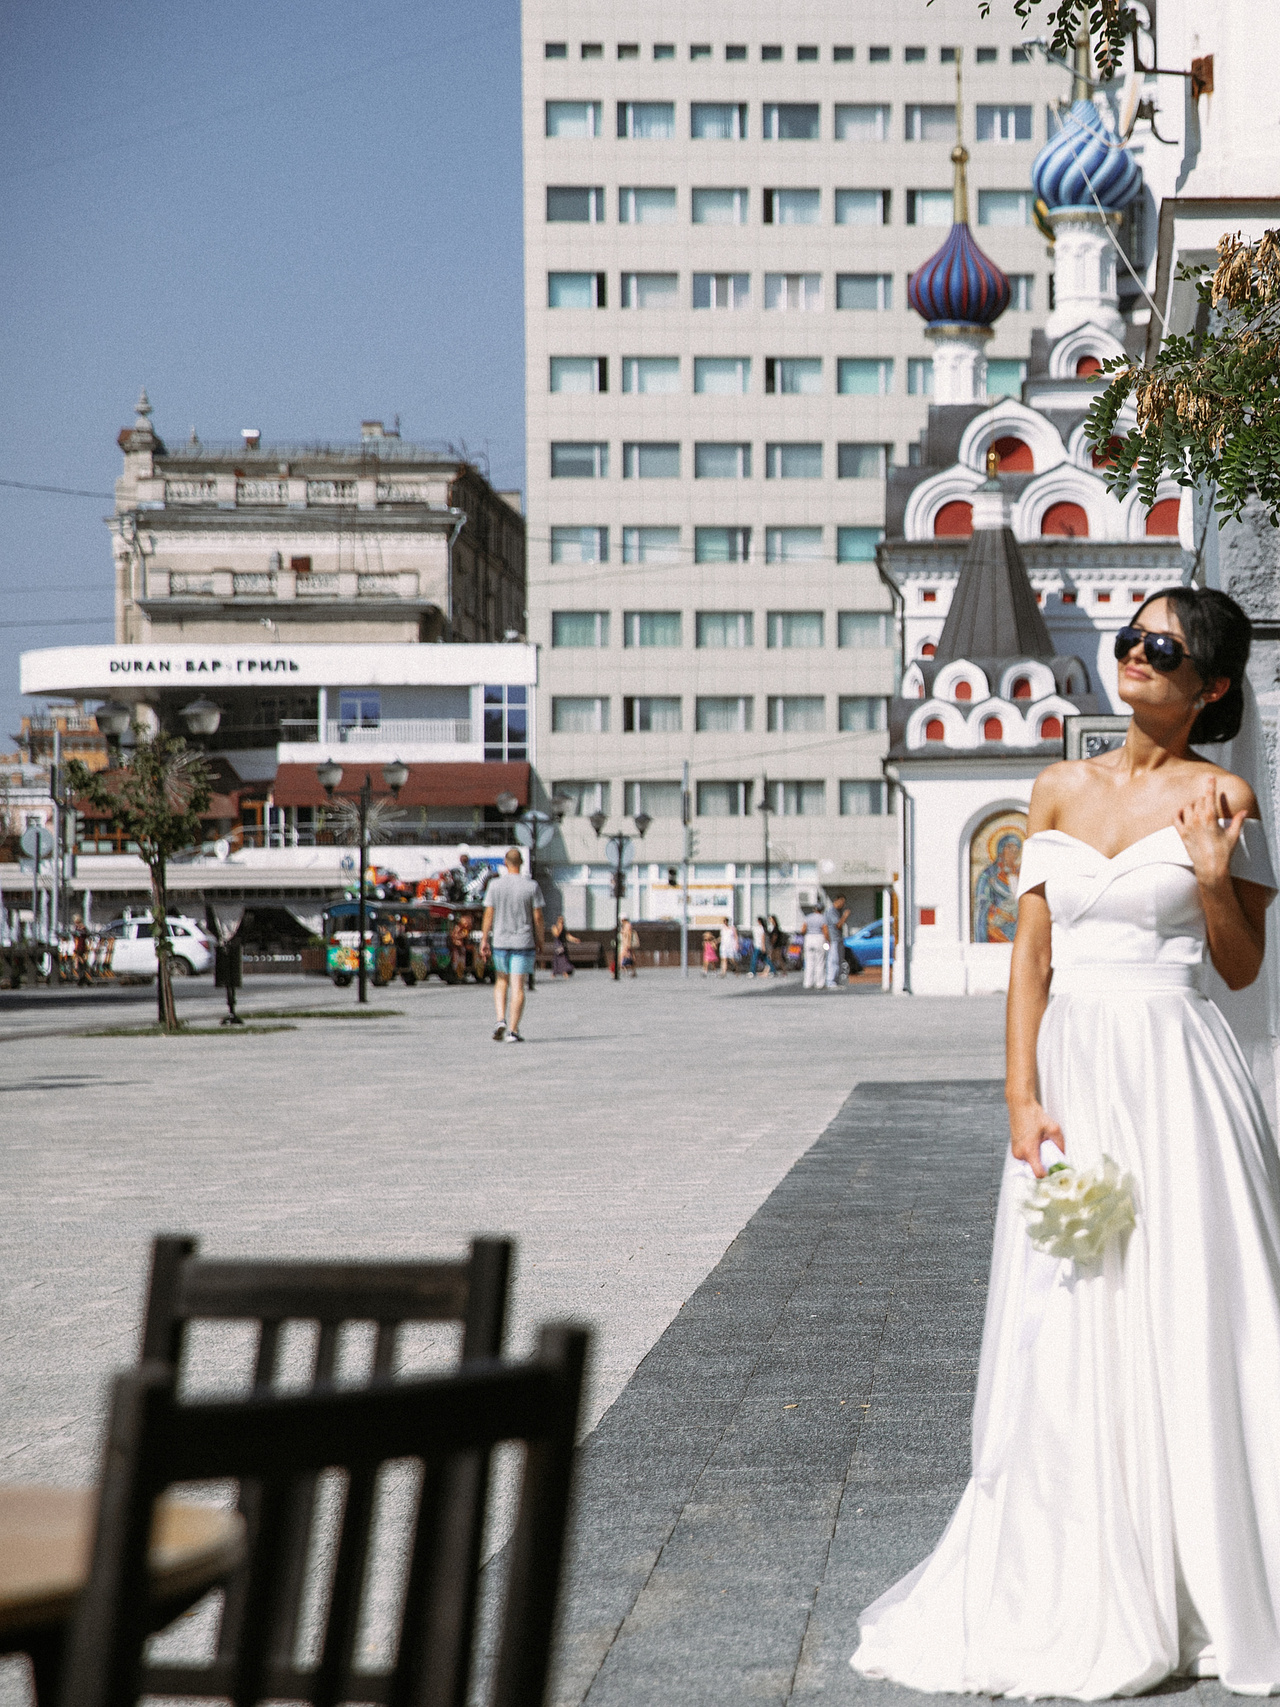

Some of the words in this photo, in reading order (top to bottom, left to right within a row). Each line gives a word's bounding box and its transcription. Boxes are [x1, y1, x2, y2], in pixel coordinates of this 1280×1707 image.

[109, 660, 171, 672] DURAN
[185, 660, 222, 672] БАР
[236, 660, 299, 672] ГРИЛЬ
